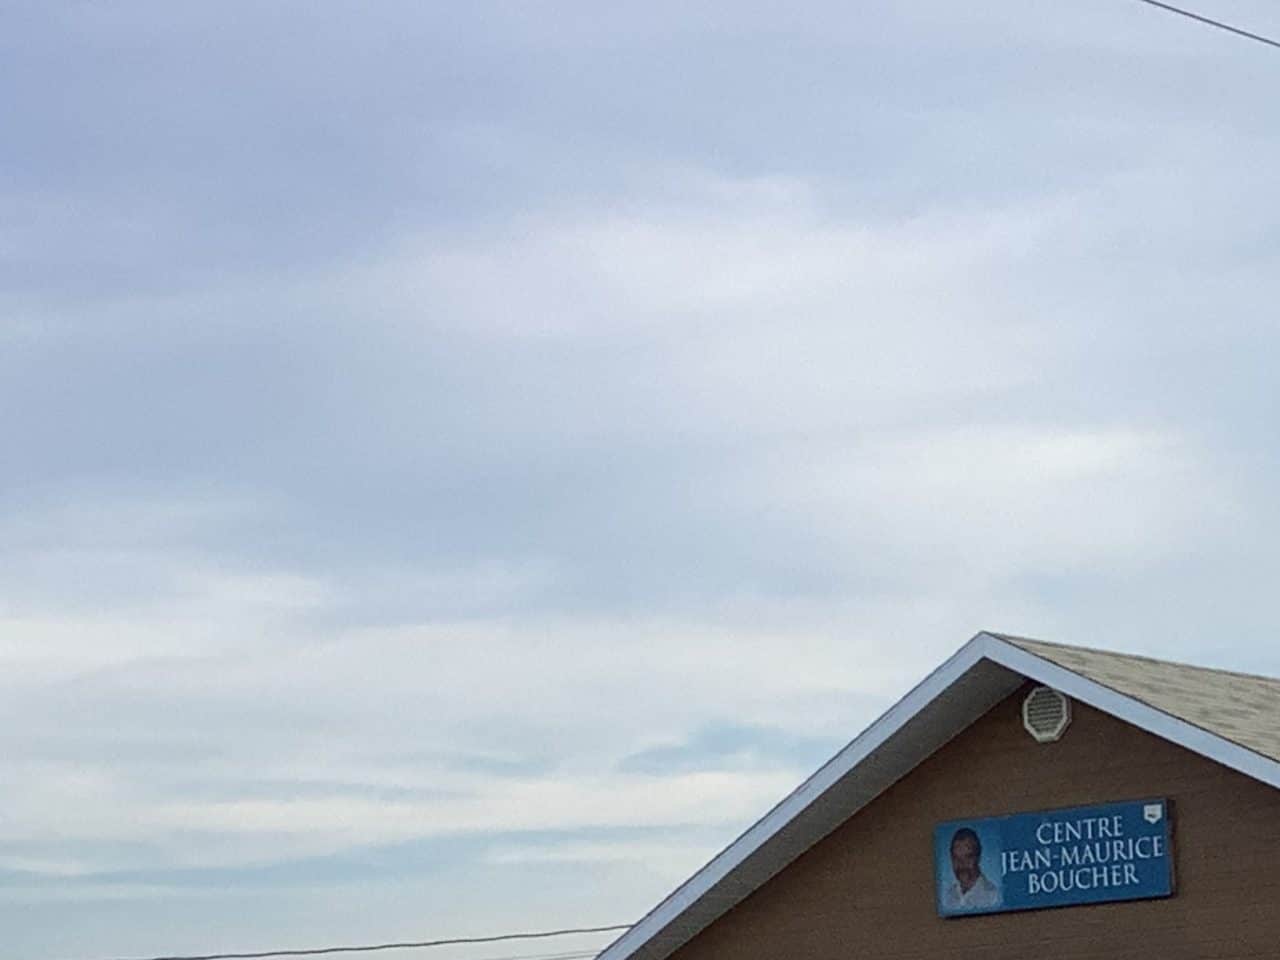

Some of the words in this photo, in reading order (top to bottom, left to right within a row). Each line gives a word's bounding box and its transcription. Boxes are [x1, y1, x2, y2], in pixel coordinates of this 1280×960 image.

[1036, 816, 1124, 845] CENTRE
[1001, 836, 1164, 876] JEAN-MAURICE
[1028, 865, 1140, 894] BOUCHER
